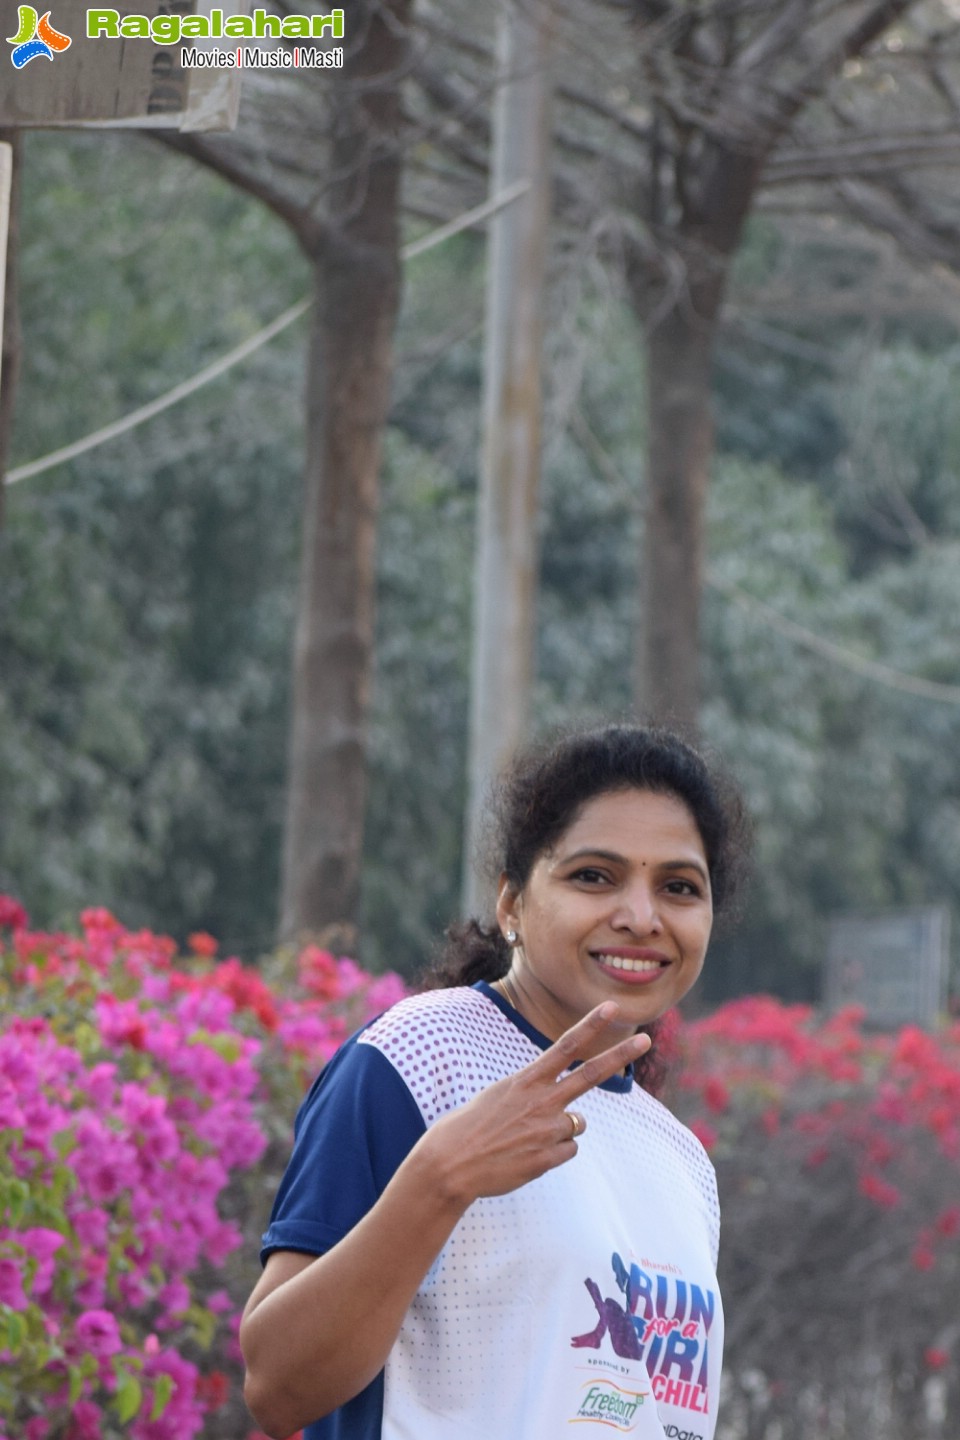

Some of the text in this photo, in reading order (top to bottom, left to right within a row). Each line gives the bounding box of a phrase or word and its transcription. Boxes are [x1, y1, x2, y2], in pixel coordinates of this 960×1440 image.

[628, 1262, 714, 1335] RUN
[642, 1317, 698, 1343] for a
